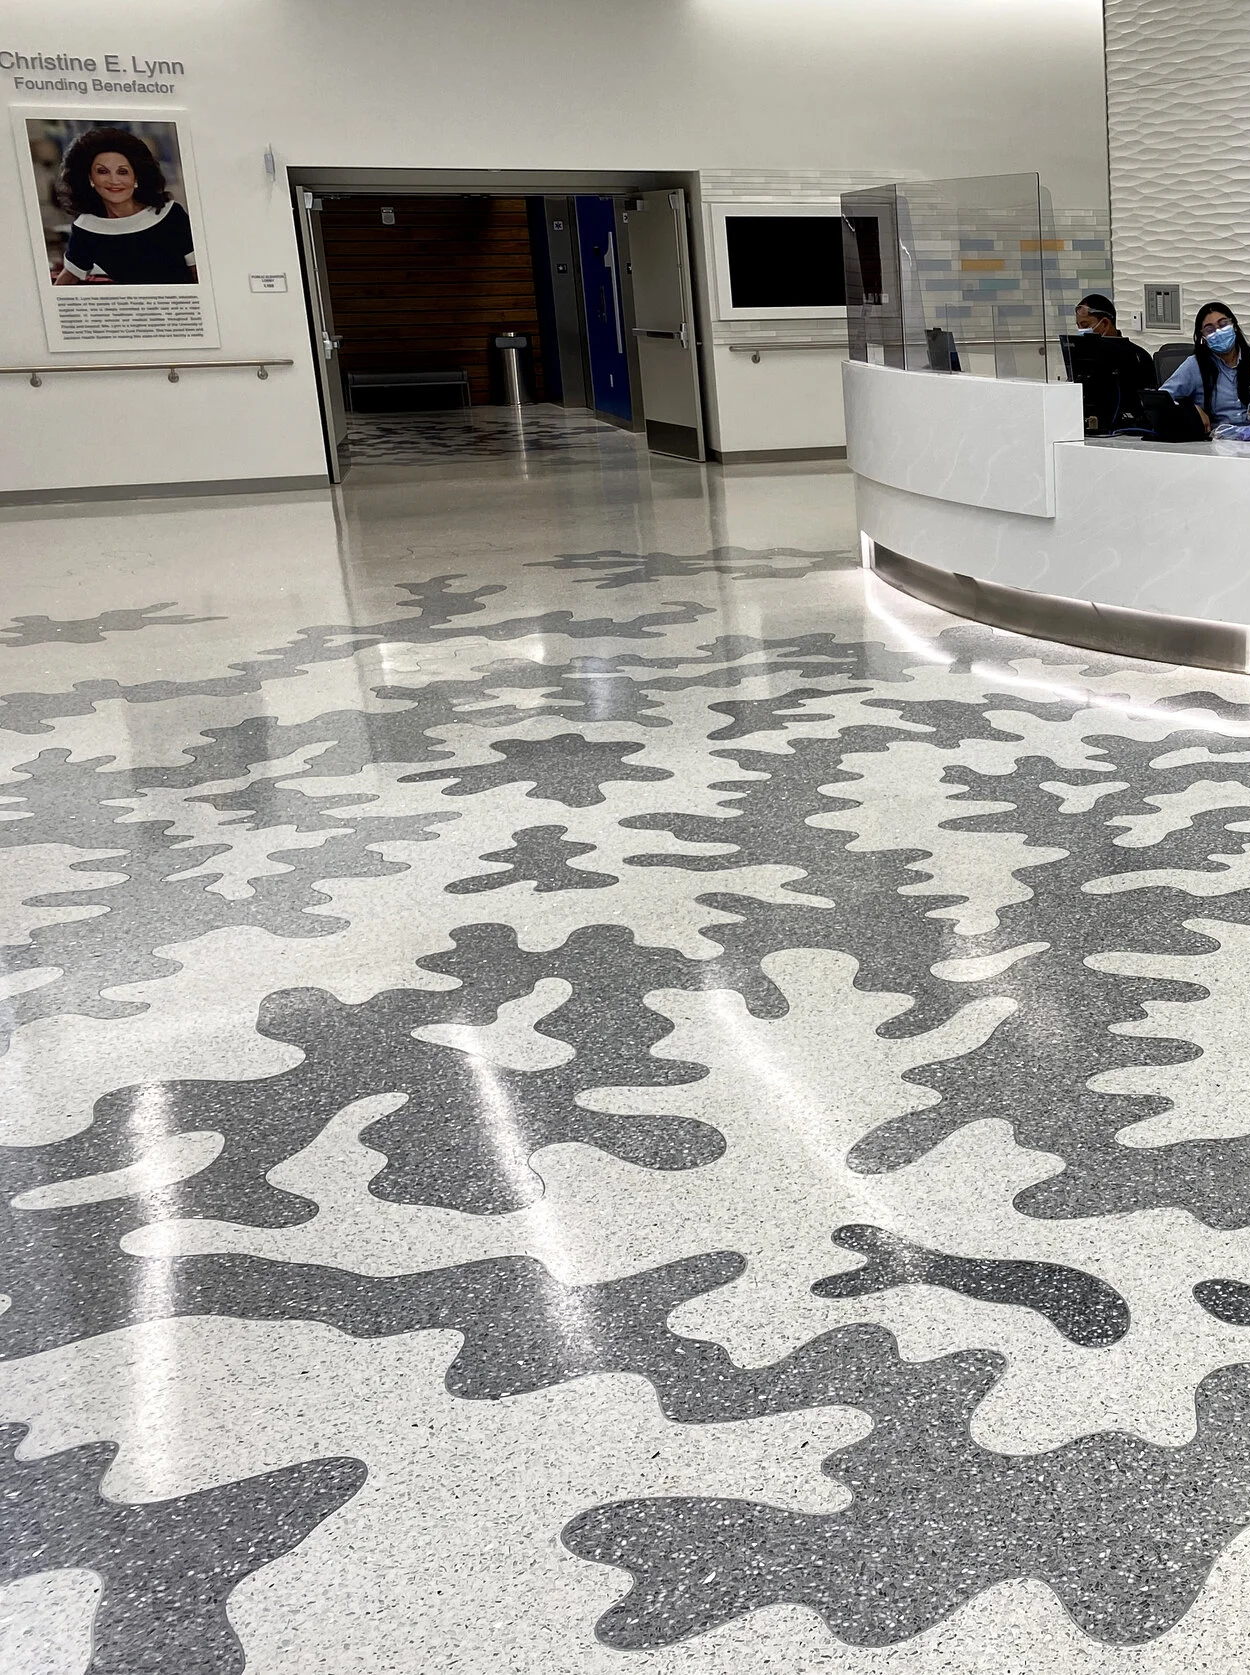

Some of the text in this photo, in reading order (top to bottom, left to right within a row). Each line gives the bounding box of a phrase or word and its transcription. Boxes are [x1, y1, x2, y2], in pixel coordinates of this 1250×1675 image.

[0, 51, 185, 78] Christine E. Lynn
[14, 76, 175, 94] Founding Benefactor
